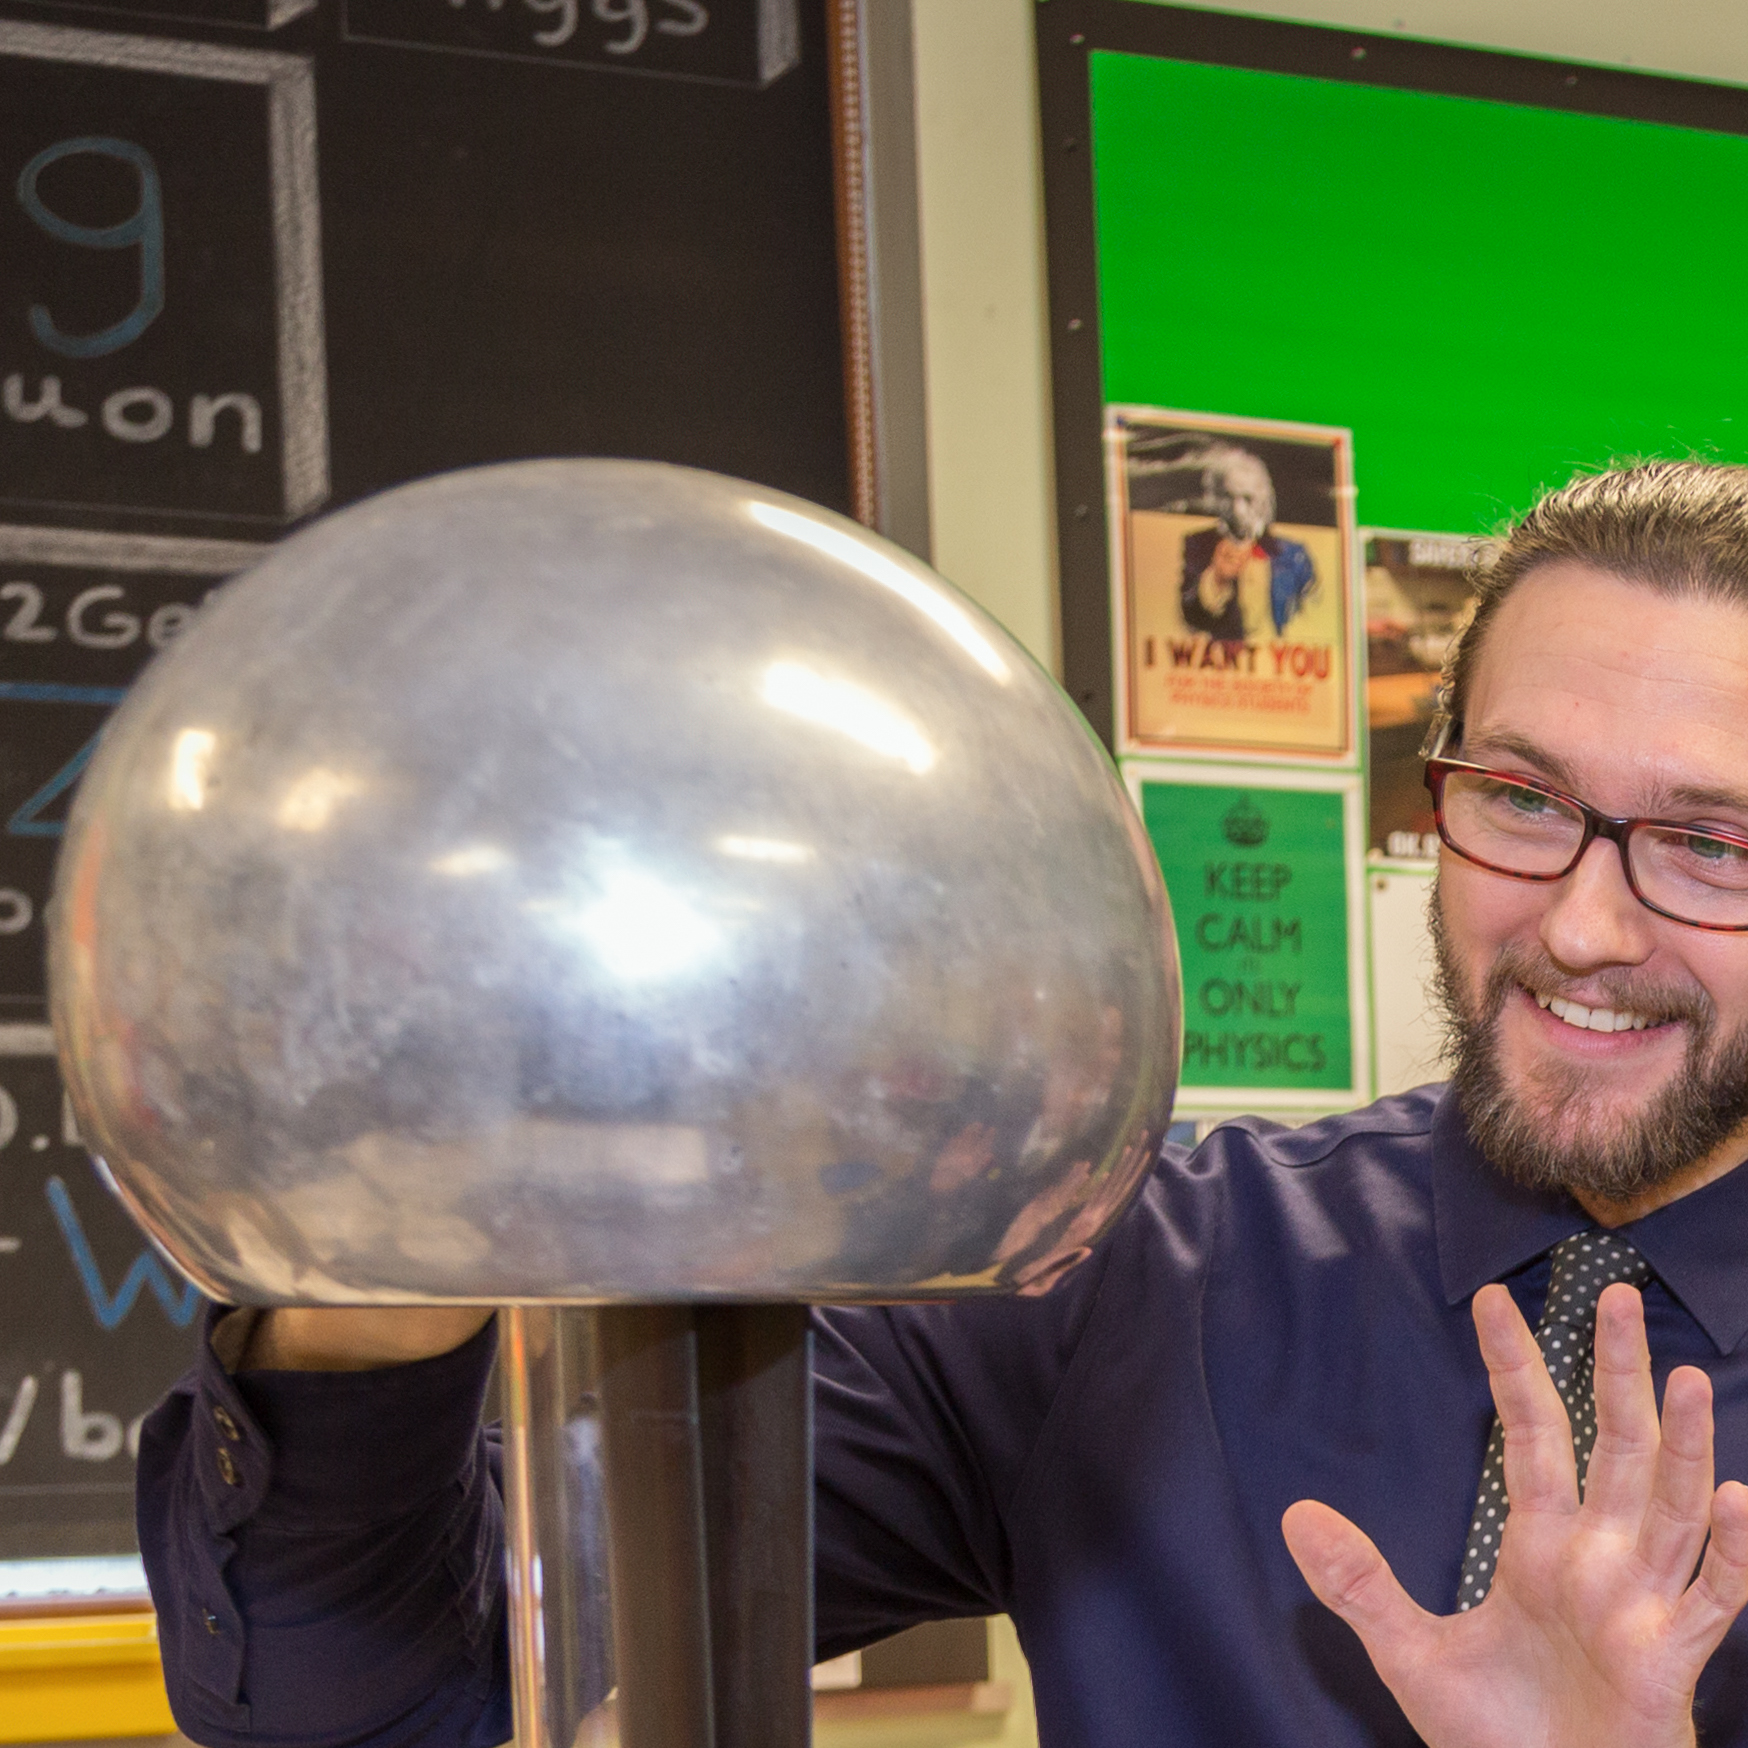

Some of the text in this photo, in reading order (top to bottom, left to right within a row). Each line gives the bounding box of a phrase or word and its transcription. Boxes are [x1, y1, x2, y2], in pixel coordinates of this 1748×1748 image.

[1166, 638, 1258, 672] WANT
[1270, 641, 1331, 679] YOU
[1203, 861, 1293, 901] KEEP
[1195, 912, 1303, 953] CALM
[1200, 977, 1303, 1019] ONLY
[1183, 1030, 1328, 1073] PHYSICS
